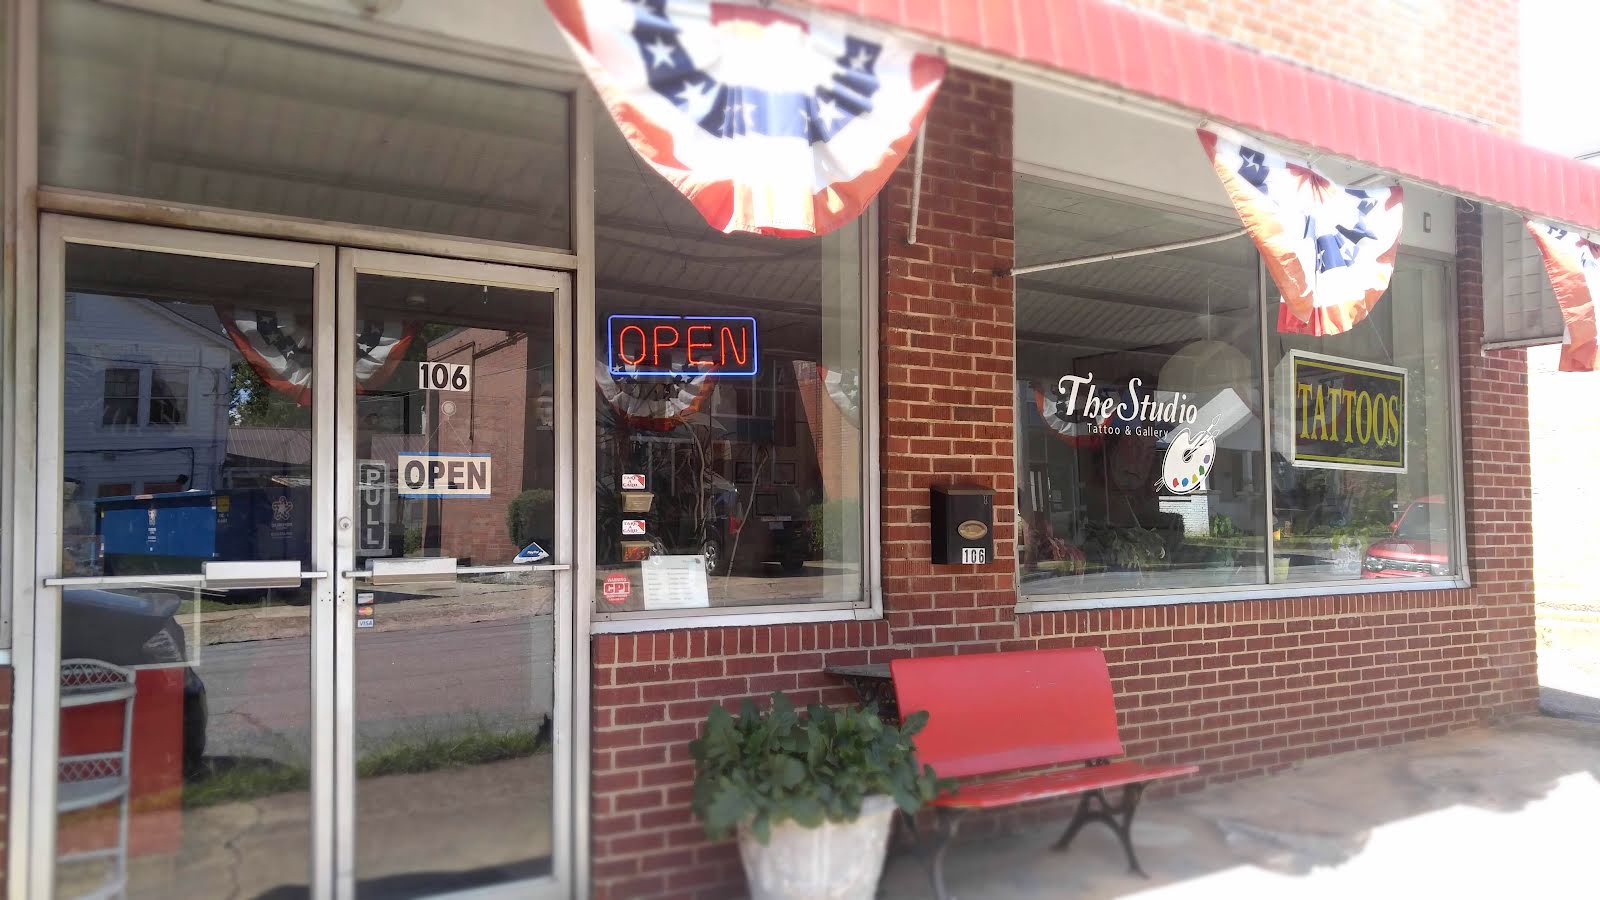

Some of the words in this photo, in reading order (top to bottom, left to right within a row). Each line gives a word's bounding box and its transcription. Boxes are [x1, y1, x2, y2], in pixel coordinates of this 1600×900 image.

[619, 325, 746, 366] OPEN
[420, 363, 468, 390] 106
[1058, 372, 1116, 419] The
[1116, 377, 1198, 424] Studio
[1087, 423, 1120, 436] Tattoo
[1124, 426, 1132, 436] &
[1135, 426, 1169, 438] Gallery
[1297, 383, 1399, 448] TATTOOS
[404, 460, 487, 490] OPEN
[365, 468, 381, 545] PULL
[964, 549, 985, 563] 106
[604, 582, 629, 594] CPI
